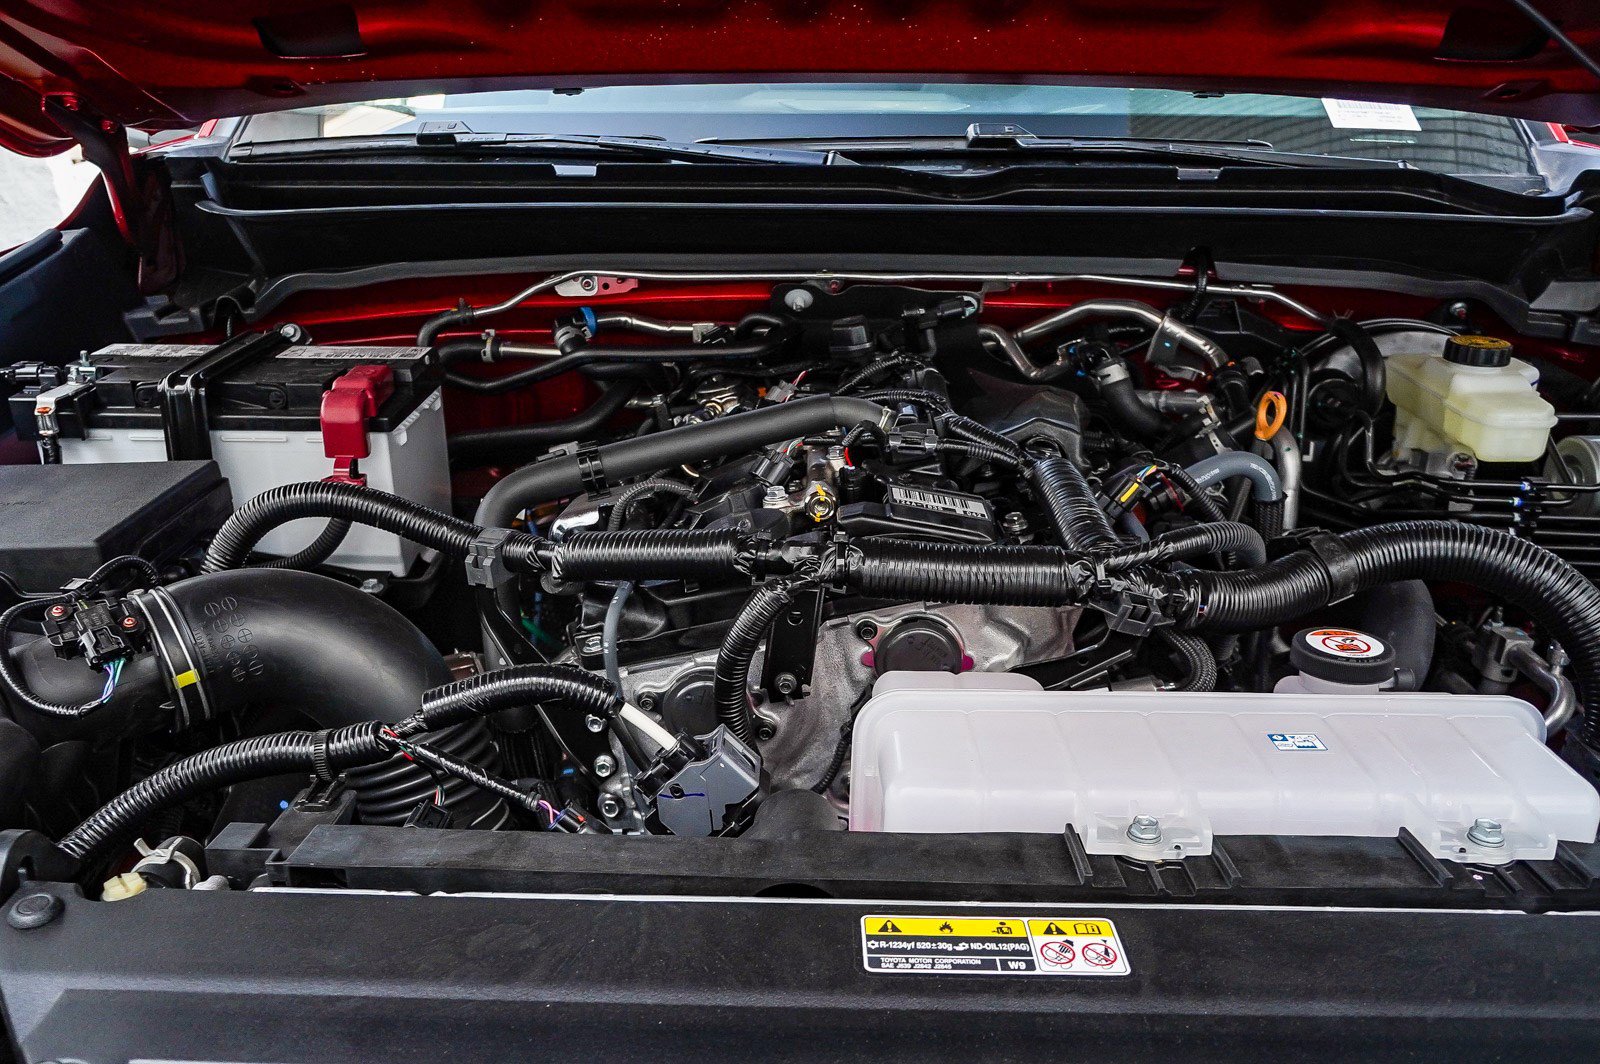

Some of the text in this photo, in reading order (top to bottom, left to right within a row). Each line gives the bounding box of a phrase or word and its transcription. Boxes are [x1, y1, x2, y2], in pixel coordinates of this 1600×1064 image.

[880, 940, 915, 950] R-1234yf
[970, 942, 1030, 952] ND-OIL12(PAG)
[1007, 960, 1027, 970] W9
